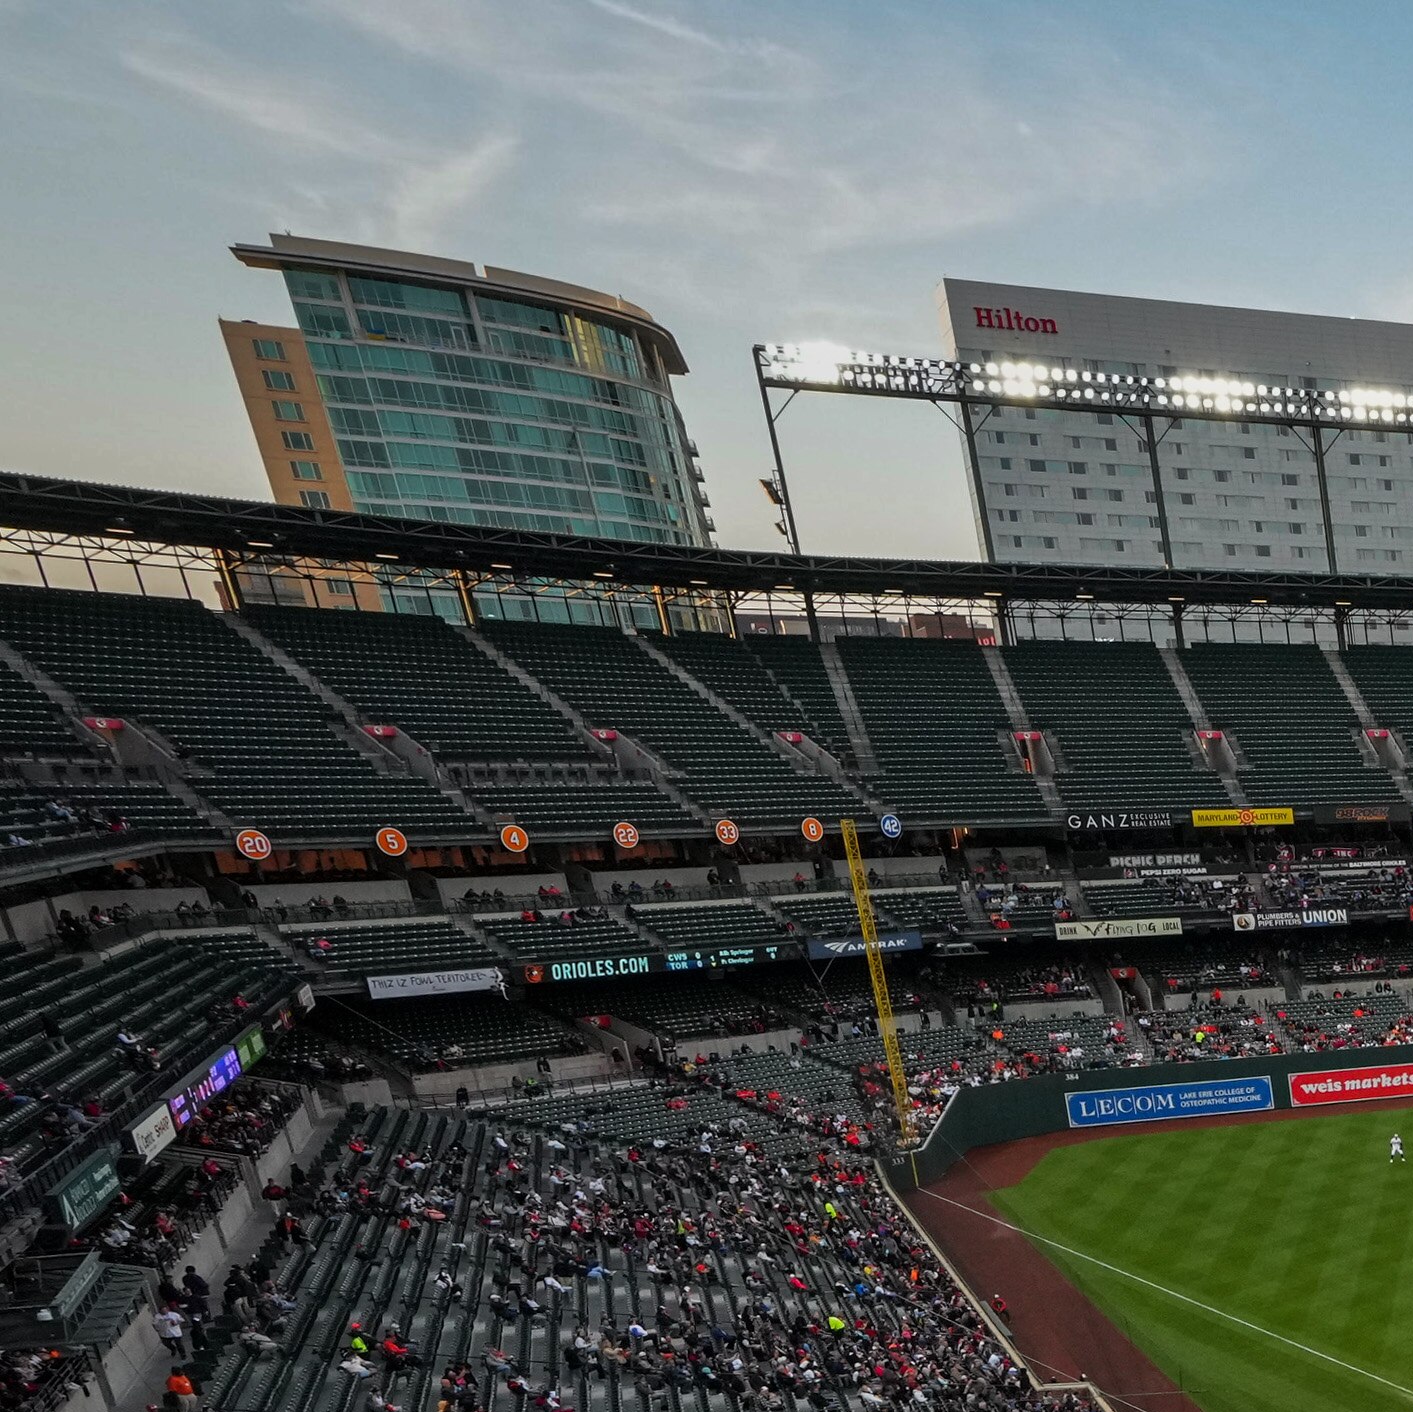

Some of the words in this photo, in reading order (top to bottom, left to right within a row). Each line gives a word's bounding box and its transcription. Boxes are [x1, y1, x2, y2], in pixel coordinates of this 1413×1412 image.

[973, 306, 1058, 334] Hilton
[1067, 814, 1130, 829] GANZ
[1130, 812, 1170, 820] EXCLUSIVE
[1197, 813, 1238, 822] MARYLAND
[1256, 812, 1287, 820] LOTTERY
[808, 823, 817, 836] 8
[884, 819, 899, 832] 42
[1149, 819, 1171, 827] ESTATE
[510, 831, 520, 846] 4
[618, 828, 635, 842] 22
[719, 826, 736, 839] 33
[242, 836, 267, 853] 20
[386, 834, 398, 849] 5
[1110, 855, 1153, 867] PICNIC
[1155, 853, 1200, 866] PERCH
[1349, 860, 1381, 868] BALTIMORE
[1382, 859, 1406, 867] ORIOLES
[1182, 867, 1207, 875] SUGAR
[1257, 912, 1295, 920] PLUMBERS
[1302, 909, 1347, 924] UNION
[1060, 927, 1077, 935] DRINK
[1162, 922, 1180, 931] LOCAL
[667, 953, 688, 961] CWS
[551, 957, 650, 980] ORIOLES.COM
[670, 961, 688, 970] TOR
[410, 976, 433, 987] FOWL
[1300, 1079, 1342, 1094] weis
[1179, 1092, 1197, 1101] LAKE
[1198, 1090, 1213, 1099] ERIE
[1214, 1088, 1247, 1098] COLLEGE
[1180, 1098, 1228, 1108] OSTEOPATHIC
[1228, 1094, 1262, 1104] MEDICINE
